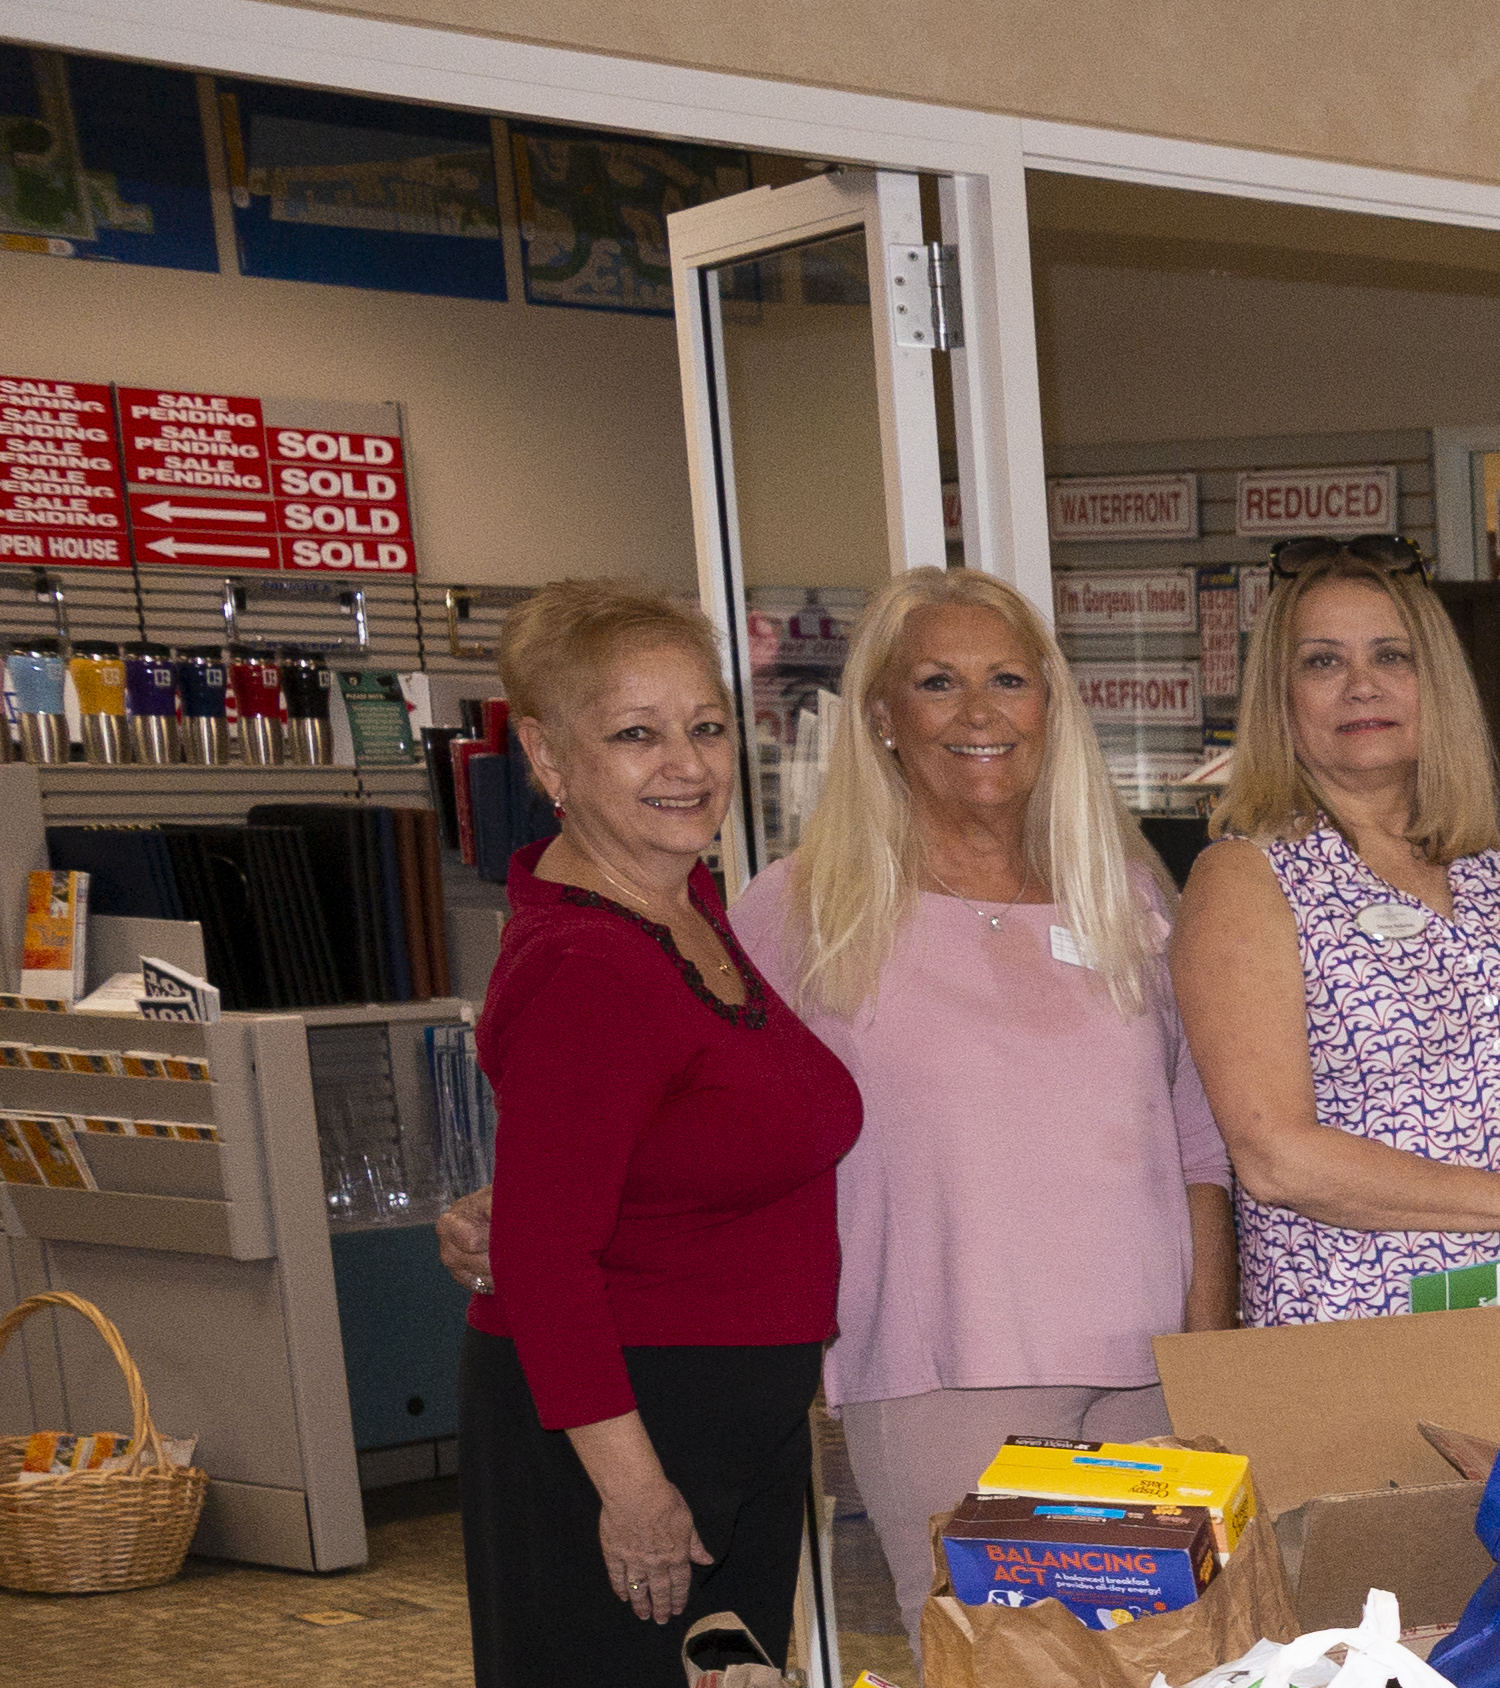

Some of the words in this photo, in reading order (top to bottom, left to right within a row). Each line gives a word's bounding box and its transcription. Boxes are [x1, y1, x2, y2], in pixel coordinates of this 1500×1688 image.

[157, 394, 230, 413] SALE
[2, 408, 79, 426] SALE
[131, 404, 257, 428] PENDING
[161, 425, 233, 443] SALE
[6, 438, 83, 457] SALE
[134, 436, 260, 459] PENDING
[277, 430, 394, 466] SOLD
[164, 455, 236, 474] SALE
[10, 467, 87, 485] SALE
[137, 467, 263, 489] PENDING
[281, 468, 397, 502] SOLD
[14, 496, 90, 513] SALE
[1061, 493, 1180, 524] WATERFRONT
[1245, 484, 1382, 519] REDUCED
[0, 509, 120, 527] ENDING
[284, 503, 400, 537] SOLD
[49, 536, 120, 561] HOUSE
[292, 540, 408, 570] SOLD
[985, 1545, 1158, 1574] BALANCING
[994, 1565, 1046, 1586] ACT
[1056, 1579, 1099, 1592] provides
[1063, 1573, 1105, 1585] balanced
[1106, 1575, 1150, 1587] breakfast
